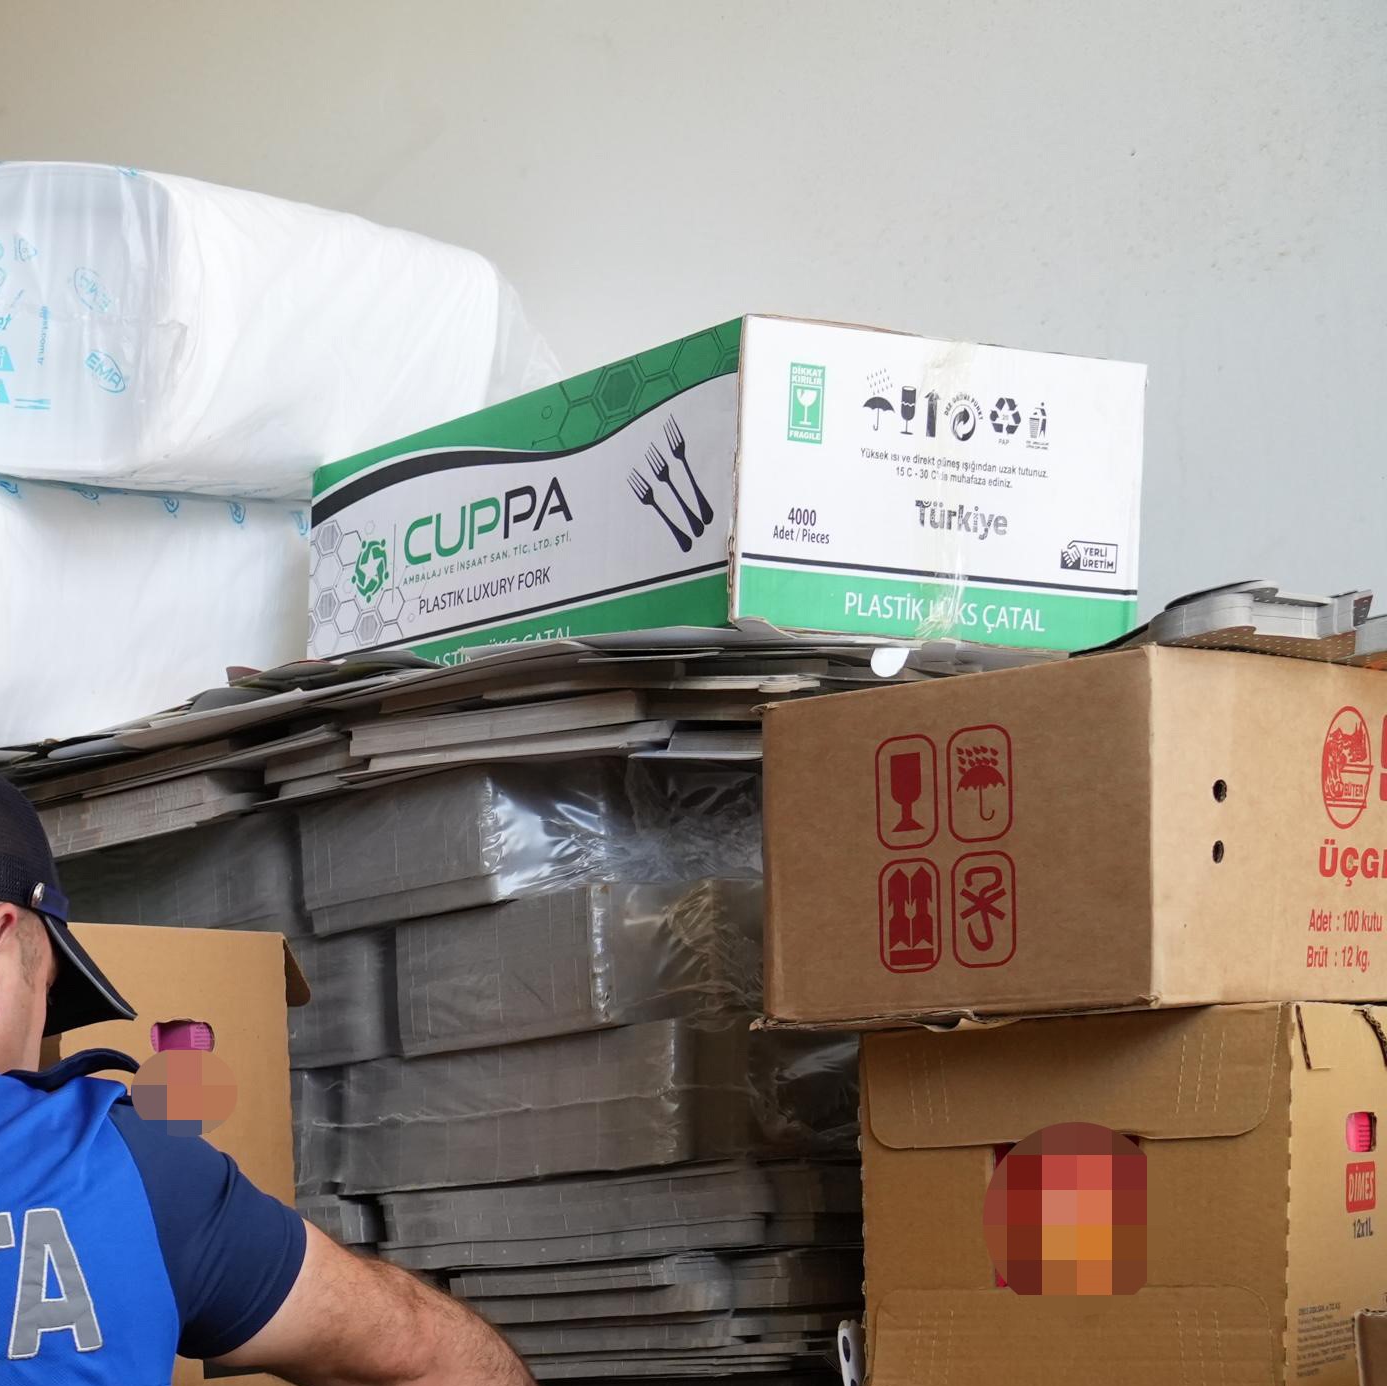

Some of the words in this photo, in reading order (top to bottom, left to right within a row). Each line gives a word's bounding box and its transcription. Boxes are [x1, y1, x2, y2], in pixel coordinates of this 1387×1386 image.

[789, 430, 821, 441] FRAGILE
[860, 448, 889, 461] Yüksek
[901, 454, 911, 463] ve
[913, 454, 936, 466] direkt
[998, 464, 1017, 475] uzak
[404, 476, 573, 565] CUPPA
[788, 507, 817, 527] 4000
[915, 499, 1008, 541] Türkiye
[773, 525, 794, 541] Adet
[802, 528, 830, 544] Pieces
[1082, 556, 1114, 570] ÜRETİM
[1084, 545, 1108, 557] YERLİ
[467, 576, 514, 604] LUXURY
[518, 566, 552, 591] FORK
[844, 591, 924, 622] PLASTİK
[982, 604, 1045, 634] ÇATAL
[1318, 838, 1387, 887] ÜÇG
[1308, 908, 1332, 932] Adet
[1342, 910, 1359, 932] 100
[1362, 910, 1382, 933] kutu
[1306, 945, 1328, 968] Brüt
[1341, 946, 1354, 967] 12
[1348, 1166, 1375, 1203] DİMES
